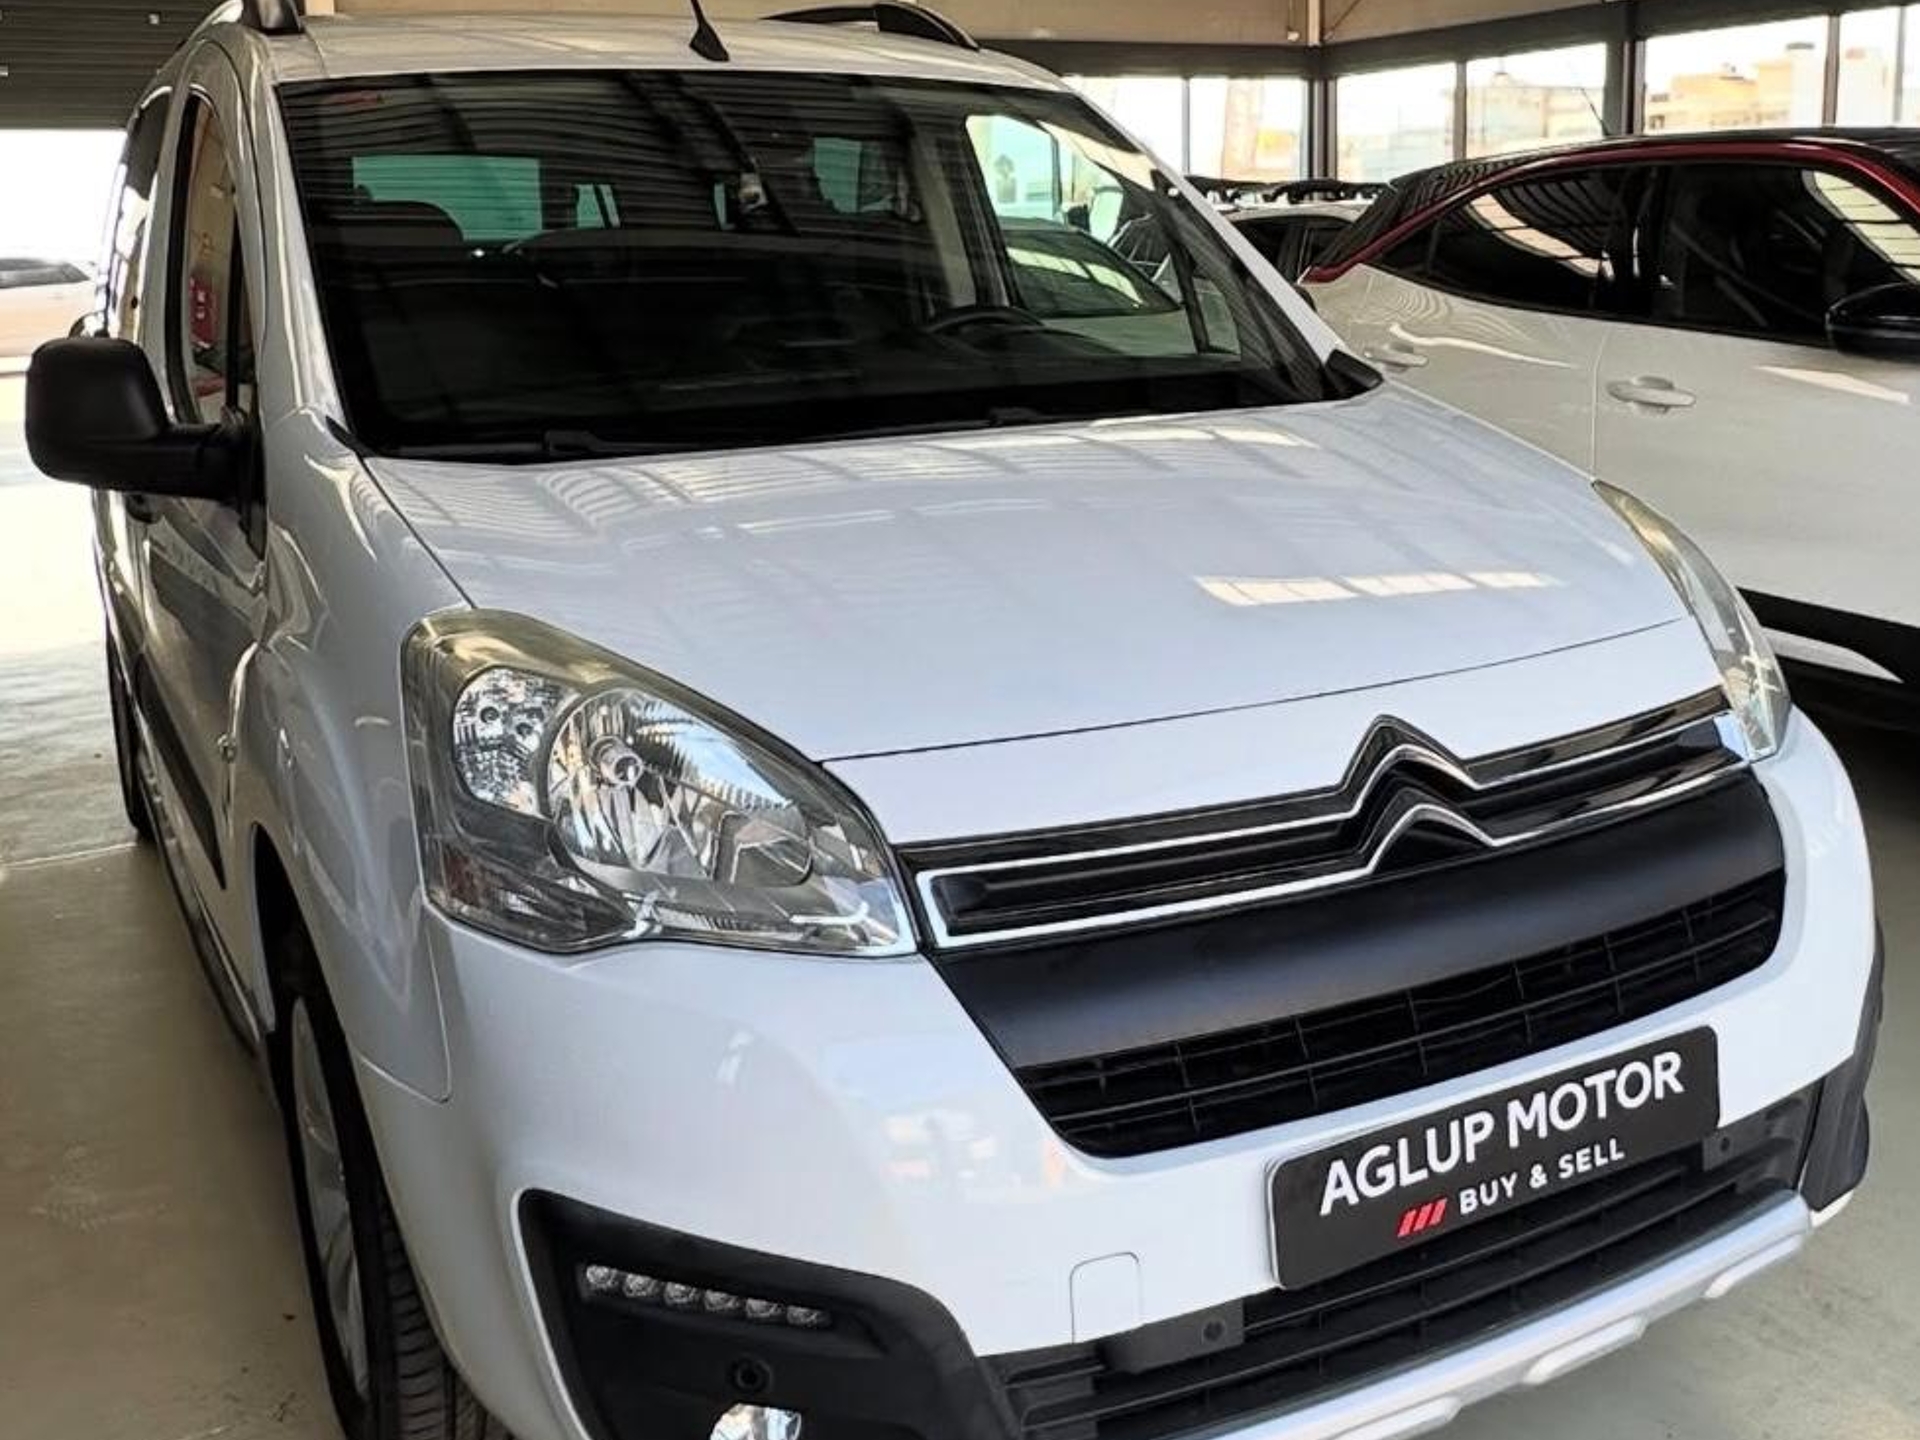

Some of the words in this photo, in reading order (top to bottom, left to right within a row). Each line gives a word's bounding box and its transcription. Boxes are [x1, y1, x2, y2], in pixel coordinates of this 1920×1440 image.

[1320, 1110, 1495, 1216] AGLUP
[1507, 1051, 1685, 1149] MOTOR
[1459, 1173, 1518, 1215] BUY
[1529, 1164, 1549, 1188] &
[1558, 1138, 1625, 1179] SELL
